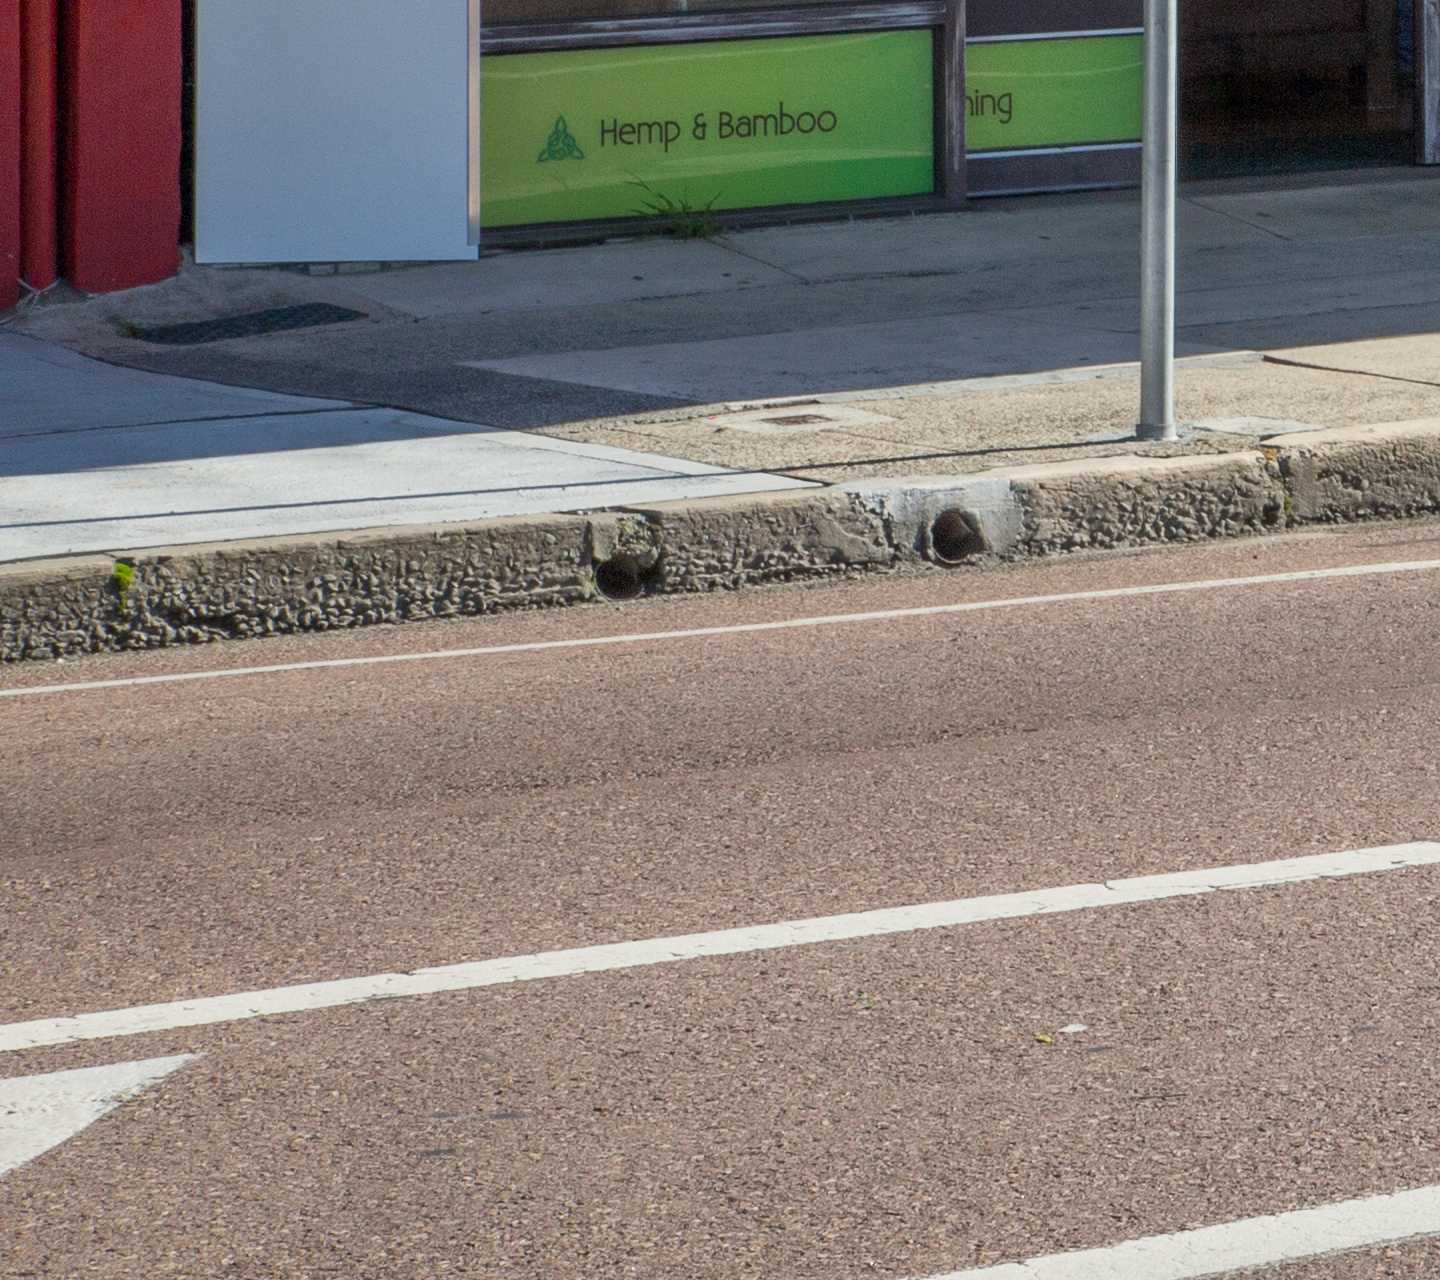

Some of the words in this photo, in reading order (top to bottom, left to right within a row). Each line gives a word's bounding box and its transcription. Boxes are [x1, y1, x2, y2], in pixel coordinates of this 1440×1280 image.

[601, 114, 681, 153] Hemp
[692, 113, 708, 139] &
[717, 101, 838, 140] Bamboo
